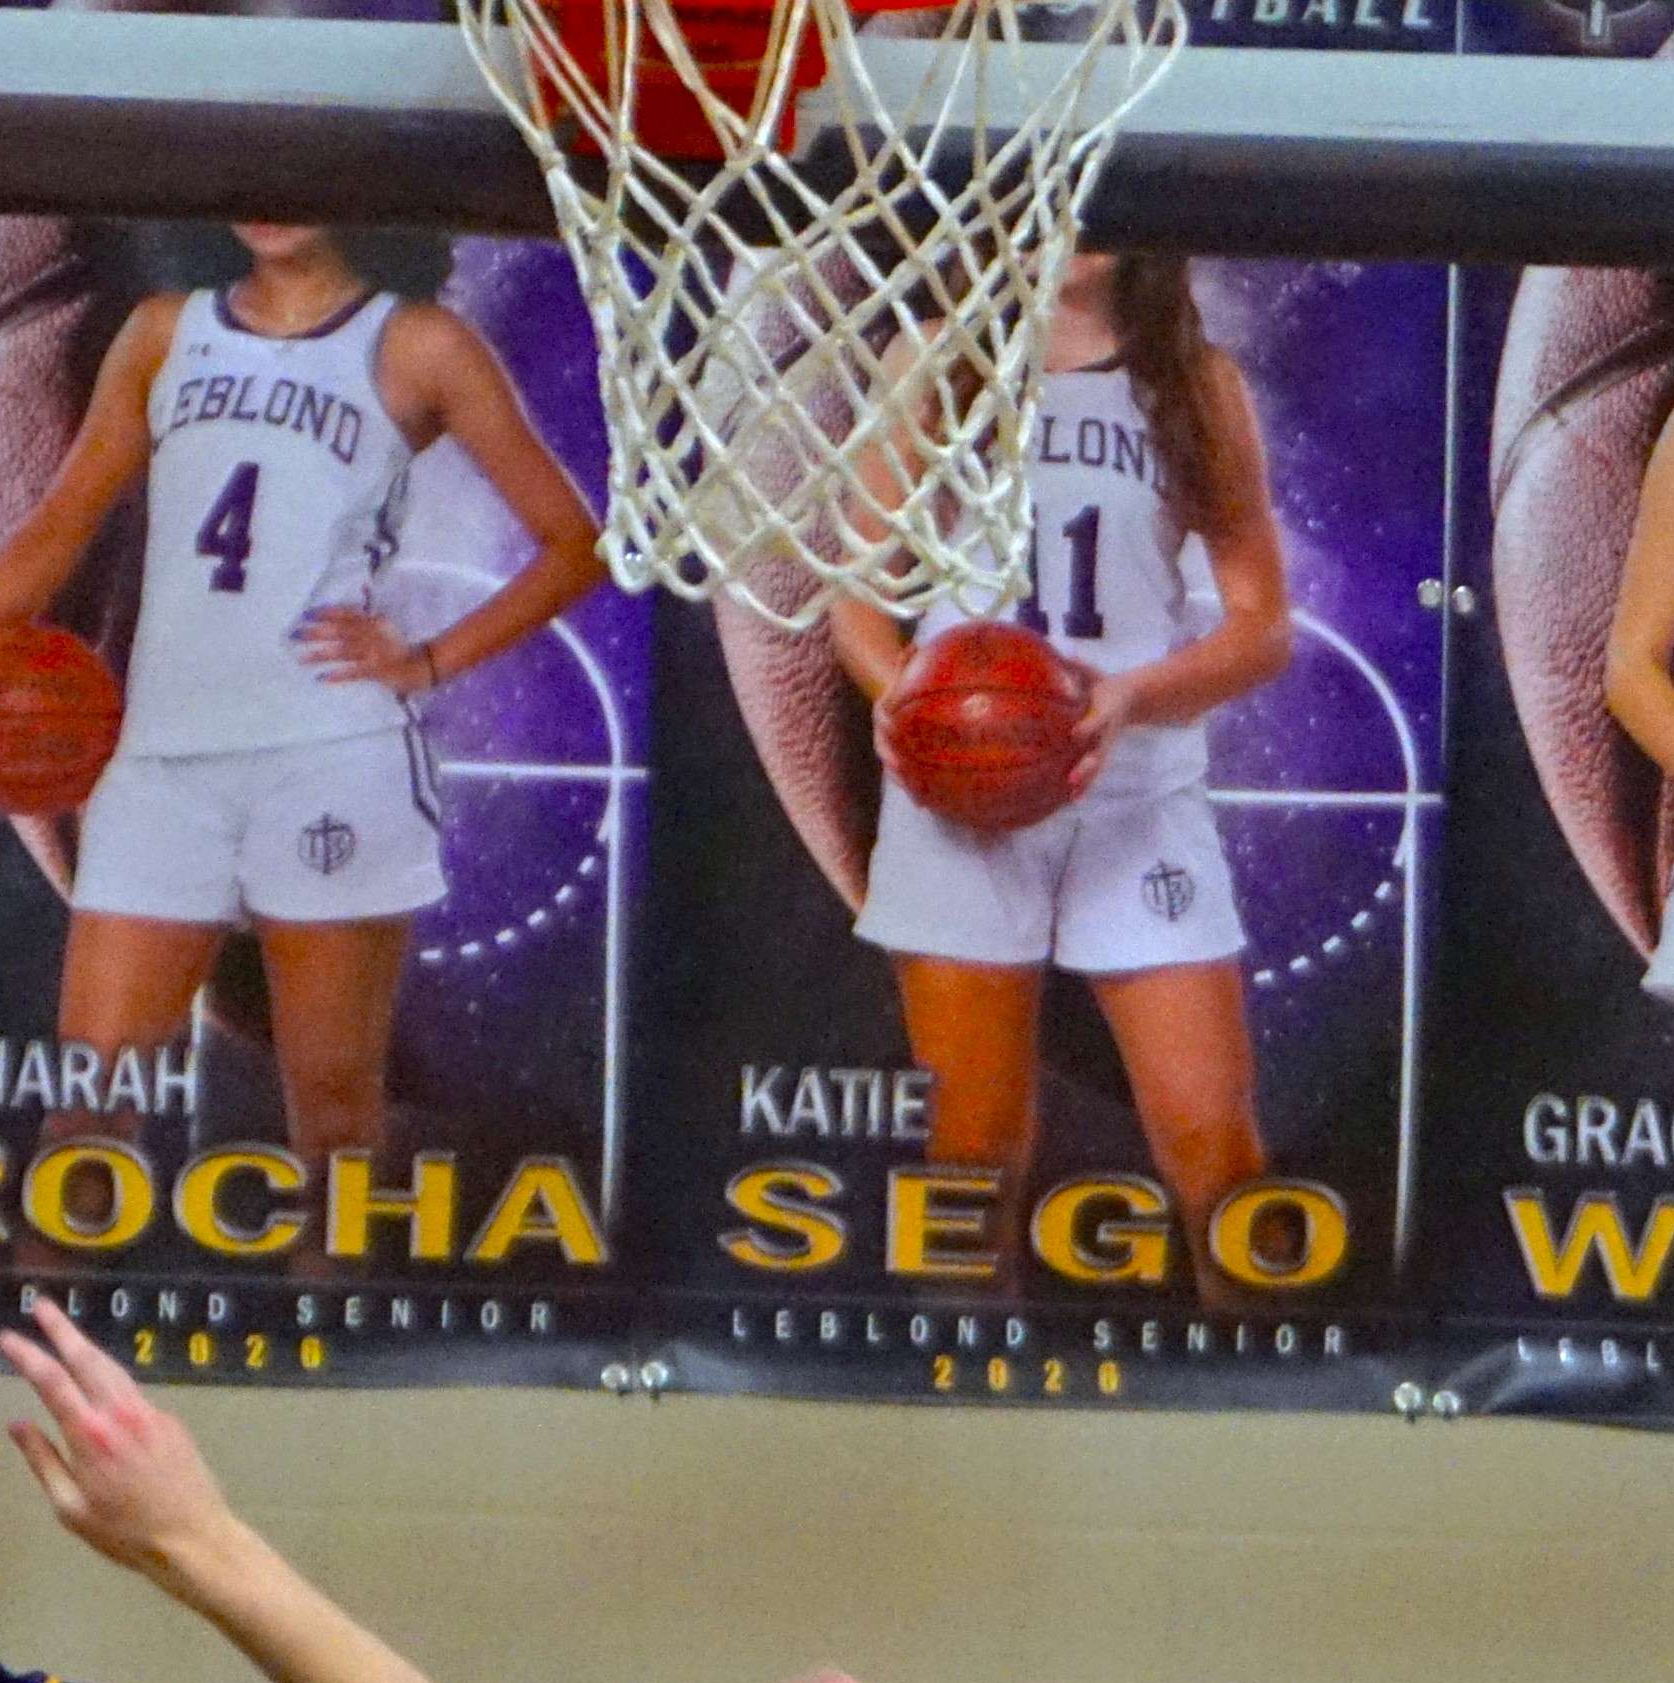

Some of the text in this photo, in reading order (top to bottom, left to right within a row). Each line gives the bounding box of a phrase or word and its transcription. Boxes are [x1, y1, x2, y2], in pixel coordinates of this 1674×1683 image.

[153, 375, 362, 464] EBLOND
[195, 460, 260, 593] 4
[740, 1065, 933, 1140] KATIE
[718, 1162, 1351, 1290] SEGO
[297, 1294, 553, 1332] SENIOR
[732, 1310, 1343, 1354] LEBLOND SENIOR
